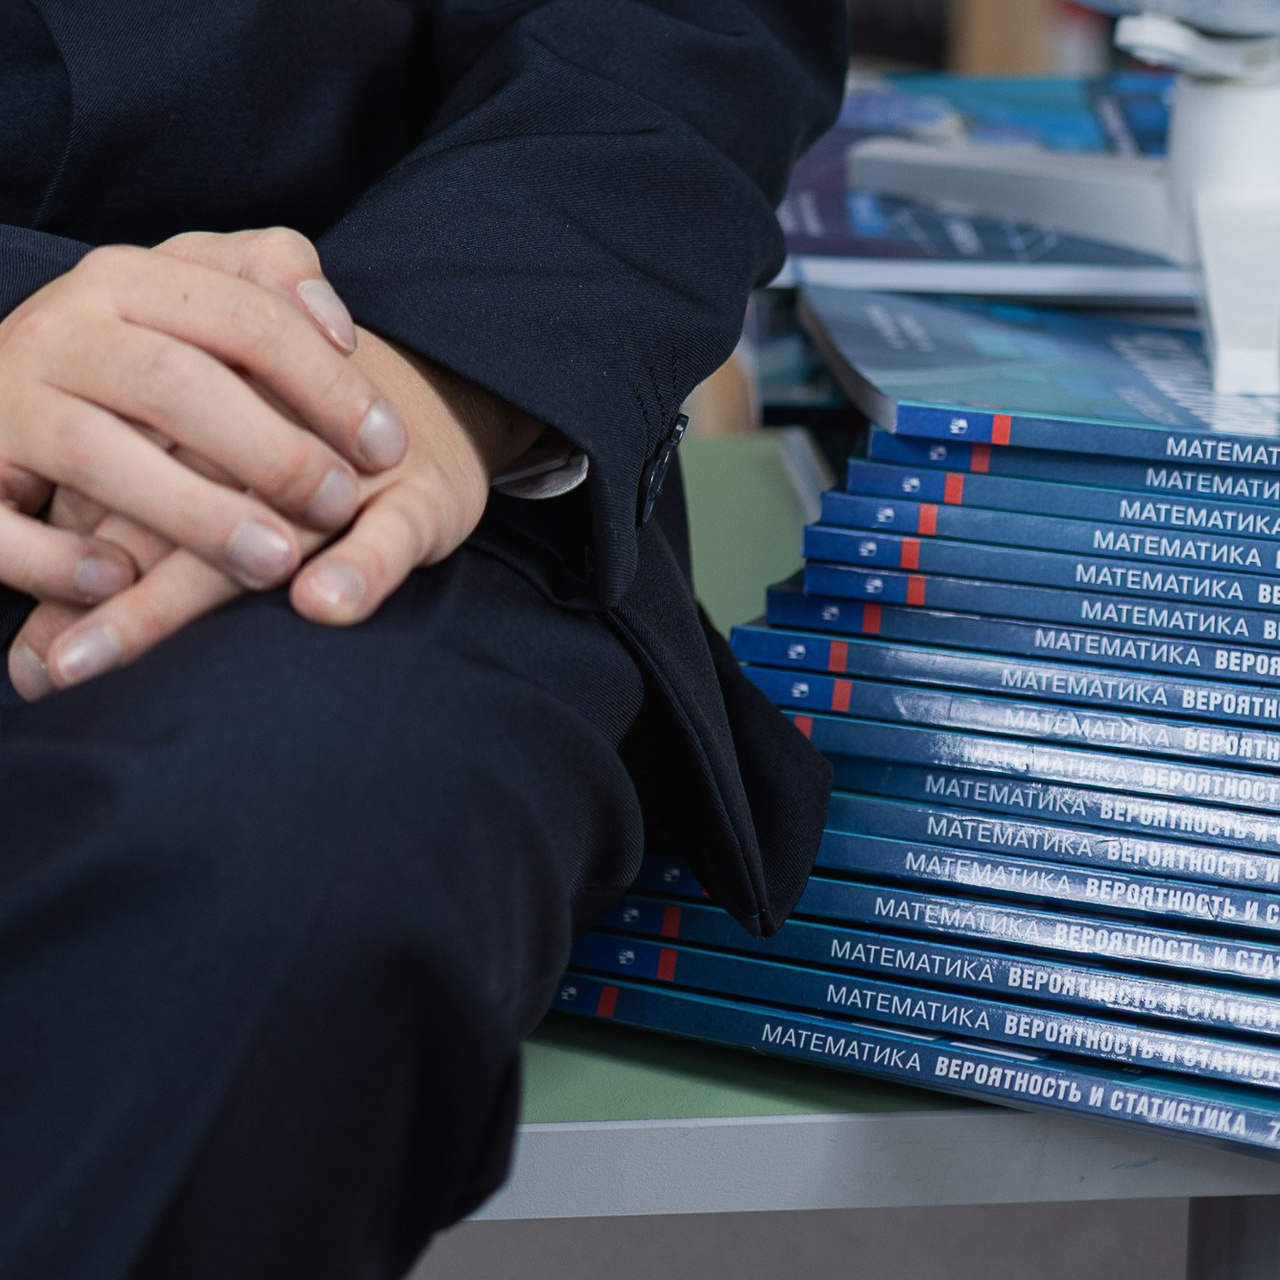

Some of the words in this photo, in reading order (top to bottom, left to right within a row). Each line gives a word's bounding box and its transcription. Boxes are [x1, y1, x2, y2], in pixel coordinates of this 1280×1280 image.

[1166, 436, 1280, 466] МАТЕМАТ
[1145, 467, 1280, 500] МАТЕМАТИ
[1092, 529, 1262, 567] МАТЕМАТИКА
[1075, 563, 1244, 601] МАТЕМАТИКА
[1080, 600, 1249, 637] МАТЕМАТИКА
[1263, 619, 1280, 640] В
[1034, 628, 1201, 667] МАТЕМАТИКА
[1214, 648, 1280, 677] ВЕРОЯ
[1000, 669, 1168, 705] МАТЕМАТИКА
[1182, 689, 1280, 720] ВЕРОЯТН
[1004, 709, 1170, 747] МАТЕМАТИКА
[1184, 730, 1280, 761] ВЕРОЯТН
[925, 774, 1087, 816] МАТЕМАТИКА
[1100, 798, 1247, 839] ВЕРОЯТНОСТЬ
[927, 816, 1093, 857] МАТЕМАТИКА
[1107, 841, 1258, 880] ВЕРОЯТНОСТЬ
[1265, 864, 1280, 883] И
[905, 851, 1070, 892] МАТЕМАТИКА
[1085, 877, 1237, 918] ВЕРОЯТНОСТЬ
[1244, 900, 1259, 922] И
[874, 896, 1039, 939] МАТЕМАТИКА
[1053, 922, 1206, 963] ВЕРОЯТНОСТЬ
[1213, 947, 1227, 967] И
[830, 939, 994, 983] МАТЕМАТИКА
[1007, 966, 1158, 1009] ВЕРОЯТНОСТЬ
[826, 984, 990, 1031] МАТЕМАТИКА
[1004, 1013, 1154, 1059] ВЕРОЯТНОСТЬ
[1161, 1043, 1177, 1064] И
[1183, 1046, 1280, 1081] СТАТИСТ
[761, 1023, 921, 1072] МАТЕМАТИКА
[934, 1056, 1082, 1103] ВЕРОЯТНОСТЬ
[1088, 1086, 1103, 1108] И
[1110, 1089, 1247, 1136] СТАТИСТИКА
